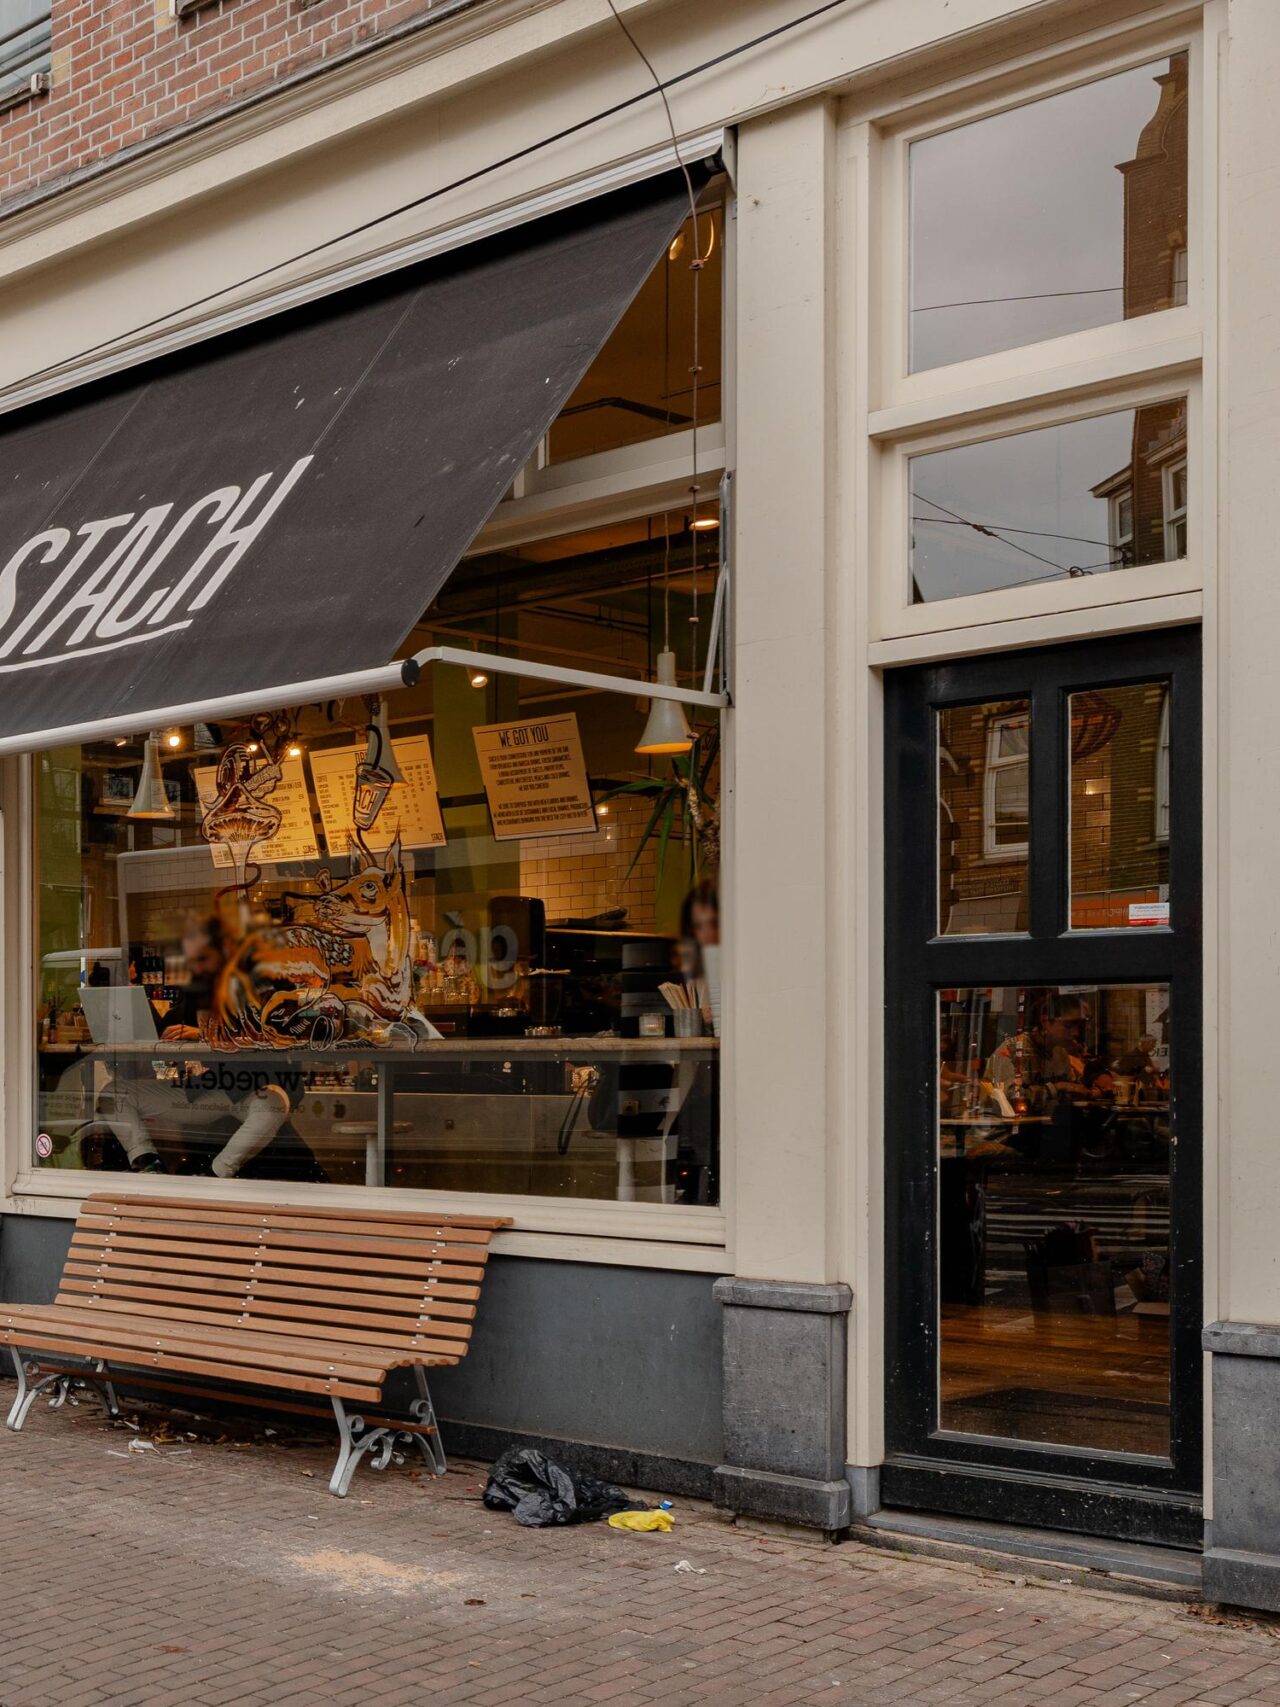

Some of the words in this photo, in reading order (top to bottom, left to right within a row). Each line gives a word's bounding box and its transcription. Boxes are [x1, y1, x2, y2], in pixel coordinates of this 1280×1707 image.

[498, 731, 512, 748] WE
[512, 728, 529, 746] GOT
[531, 725, 549, 743] YOU
